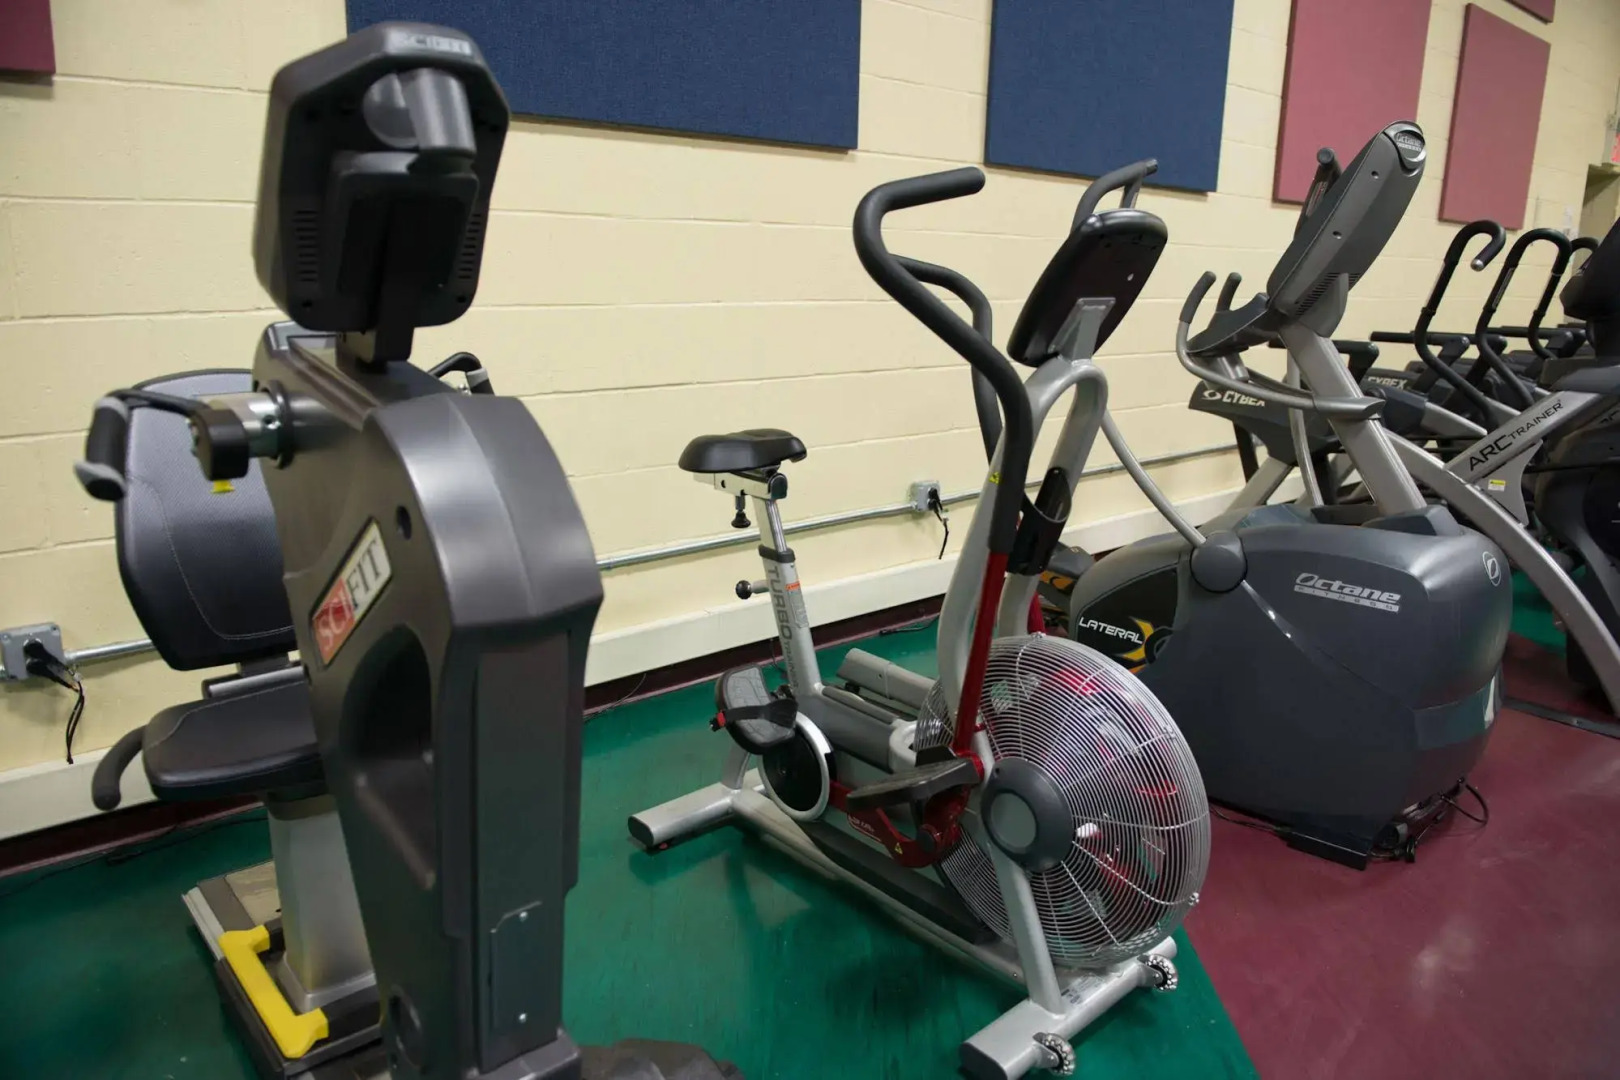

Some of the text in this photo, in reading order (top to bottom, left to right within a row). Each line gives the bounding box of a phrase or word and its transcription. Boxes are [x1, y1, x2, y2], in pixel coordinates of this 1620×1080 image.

[1469, 402, 1563, 471] ARC TRAINER
[318, 538, 382, 654] SCIFIT
[767, 565, 793, 640] TURBO
[1295, 572, 1401, 604] Octane
